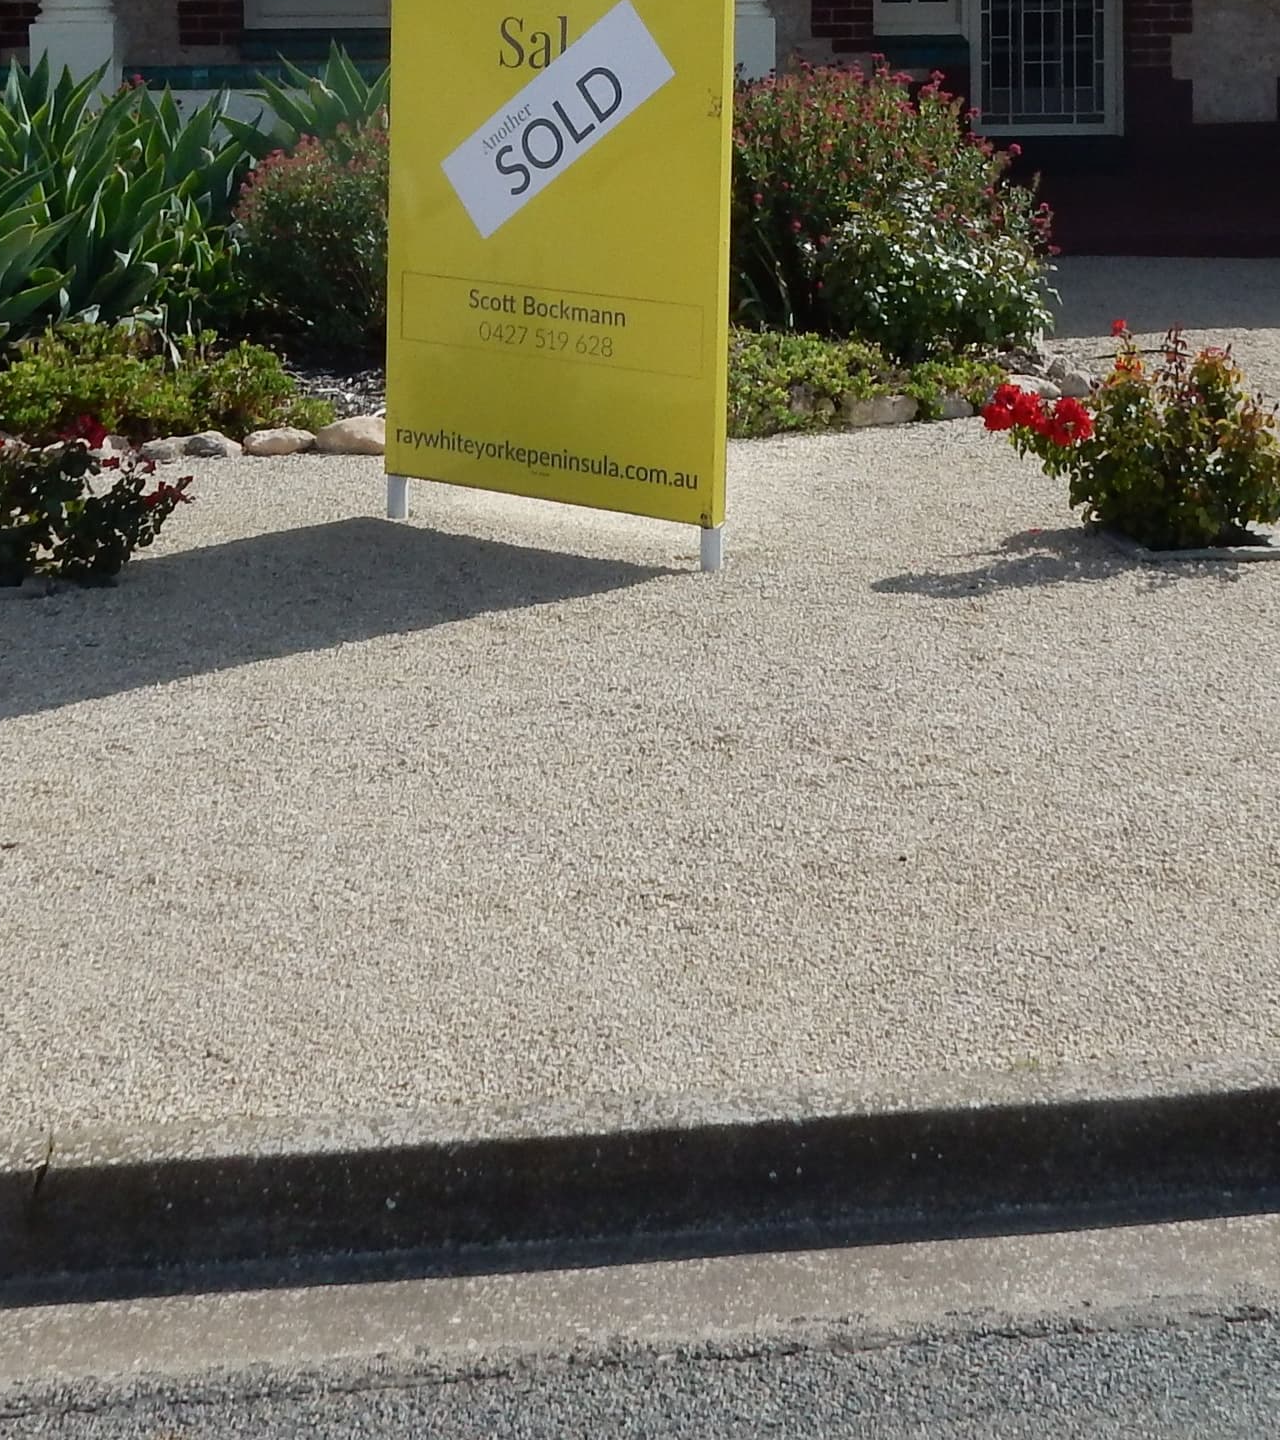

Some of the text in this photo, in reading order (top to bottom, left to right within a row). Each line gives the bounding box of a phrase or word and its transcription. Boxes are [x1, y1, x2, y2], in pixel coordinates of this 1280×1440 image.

[499, 16, 568, 69] Sal
[482, 103, 532, 155] Another
[495, 66, 622, 196] SOLD
[469, 288, 626, 327] Scott Bockmann
[479, 321, 613, 358] 0427 519 628
[396, 426, 698, 490] raywhiteyorkepeninsula.com.au
